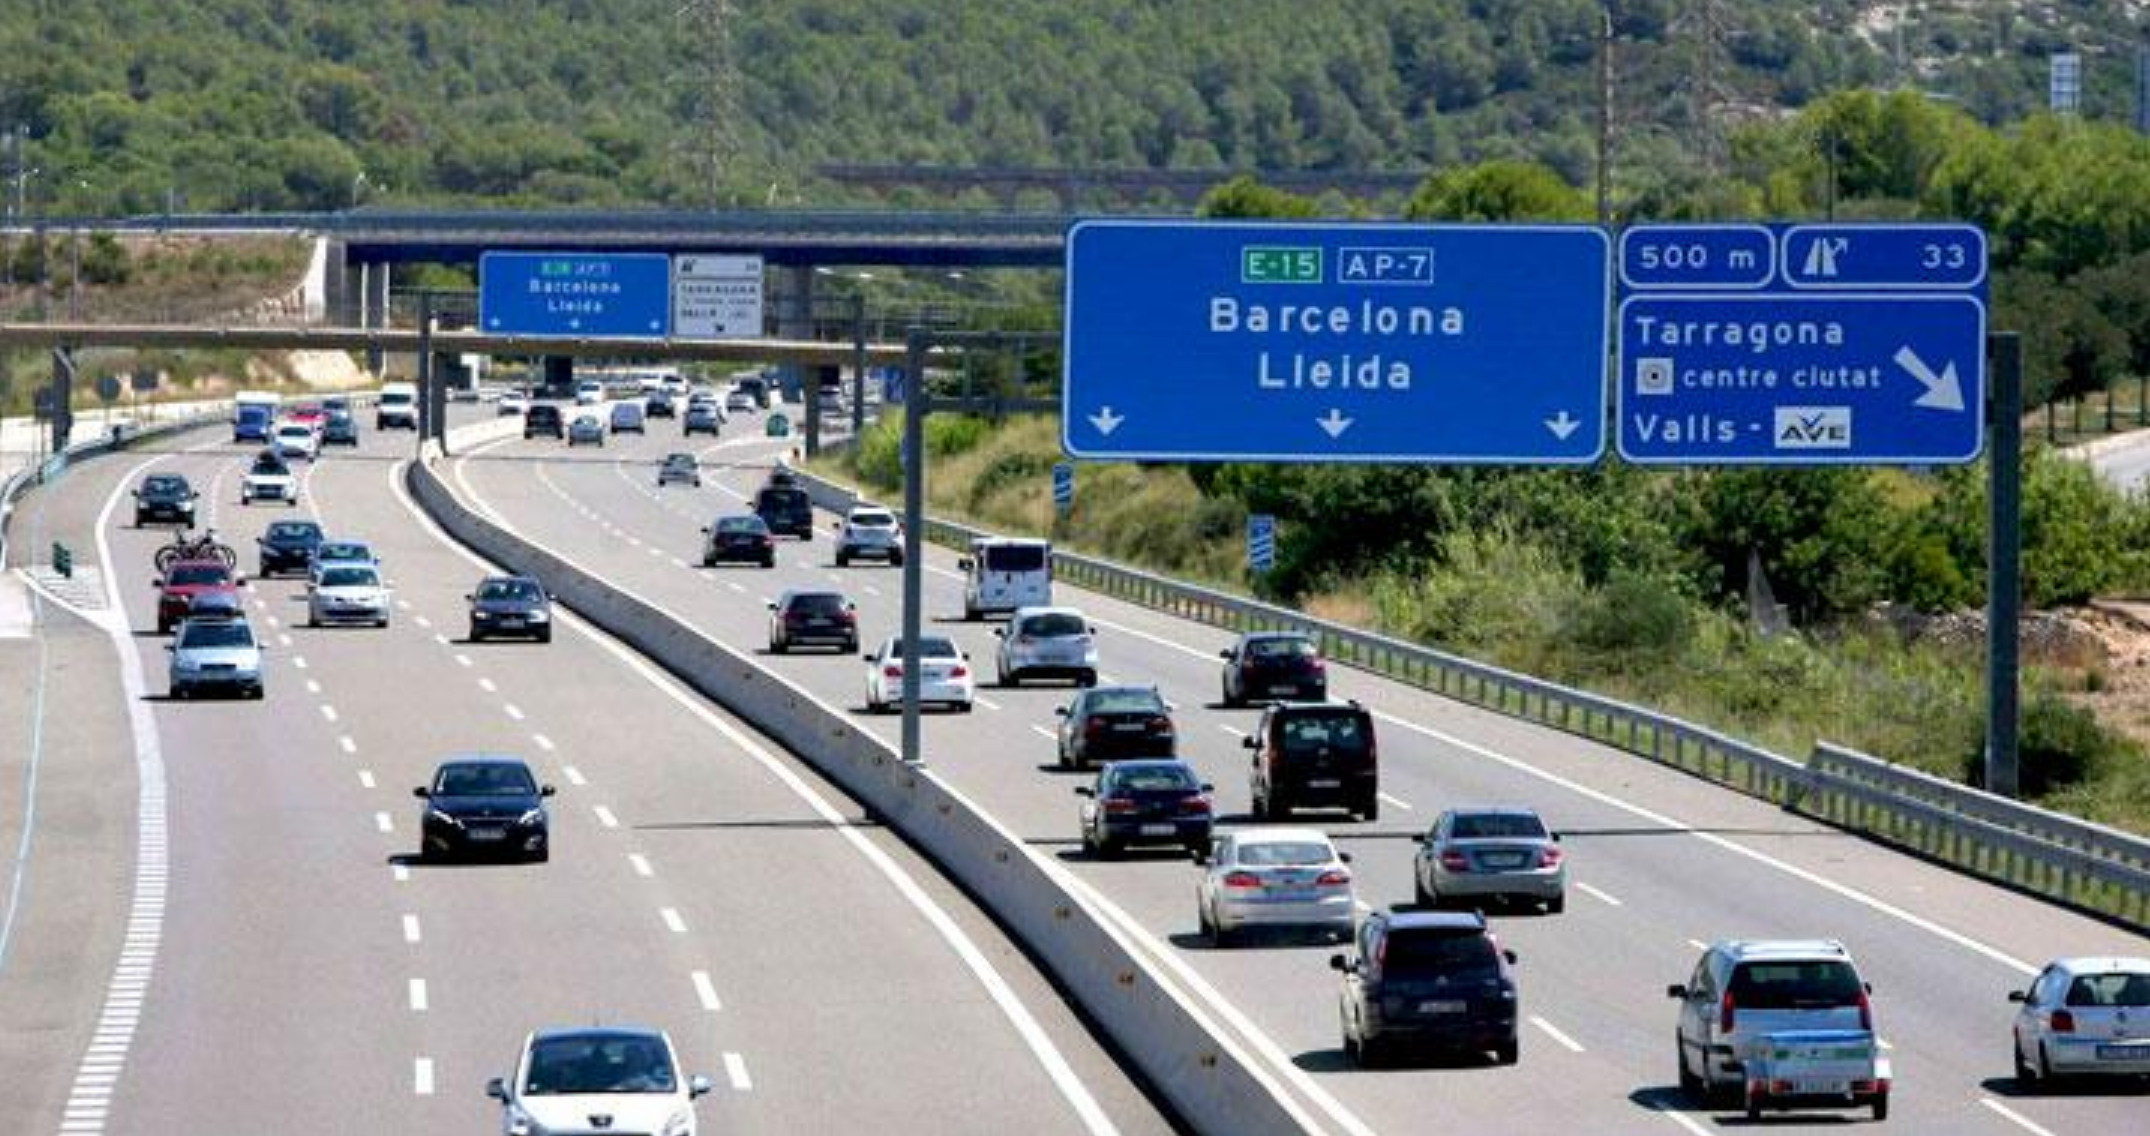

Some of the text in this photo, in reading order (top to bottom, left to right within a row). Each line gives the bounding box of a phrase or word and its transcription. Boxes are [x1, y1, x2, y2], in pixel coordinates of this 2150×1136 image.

[1248, 253, 1315, 277] E-15
[1346, 254, 1427, 277] AP-7
[1641, 245, 1755, 269] 500 m
[1922, 244, 1966, 269] 33
[1211, 297, 1464, 334] Barcelona
[1635, 316, 1844, 352] Tarragona
[1259, 353, 1411, 389] Lleida
[1683, 365, 1881, 389] centre ciutat
[1635, 413, 1736, 443] Valls
